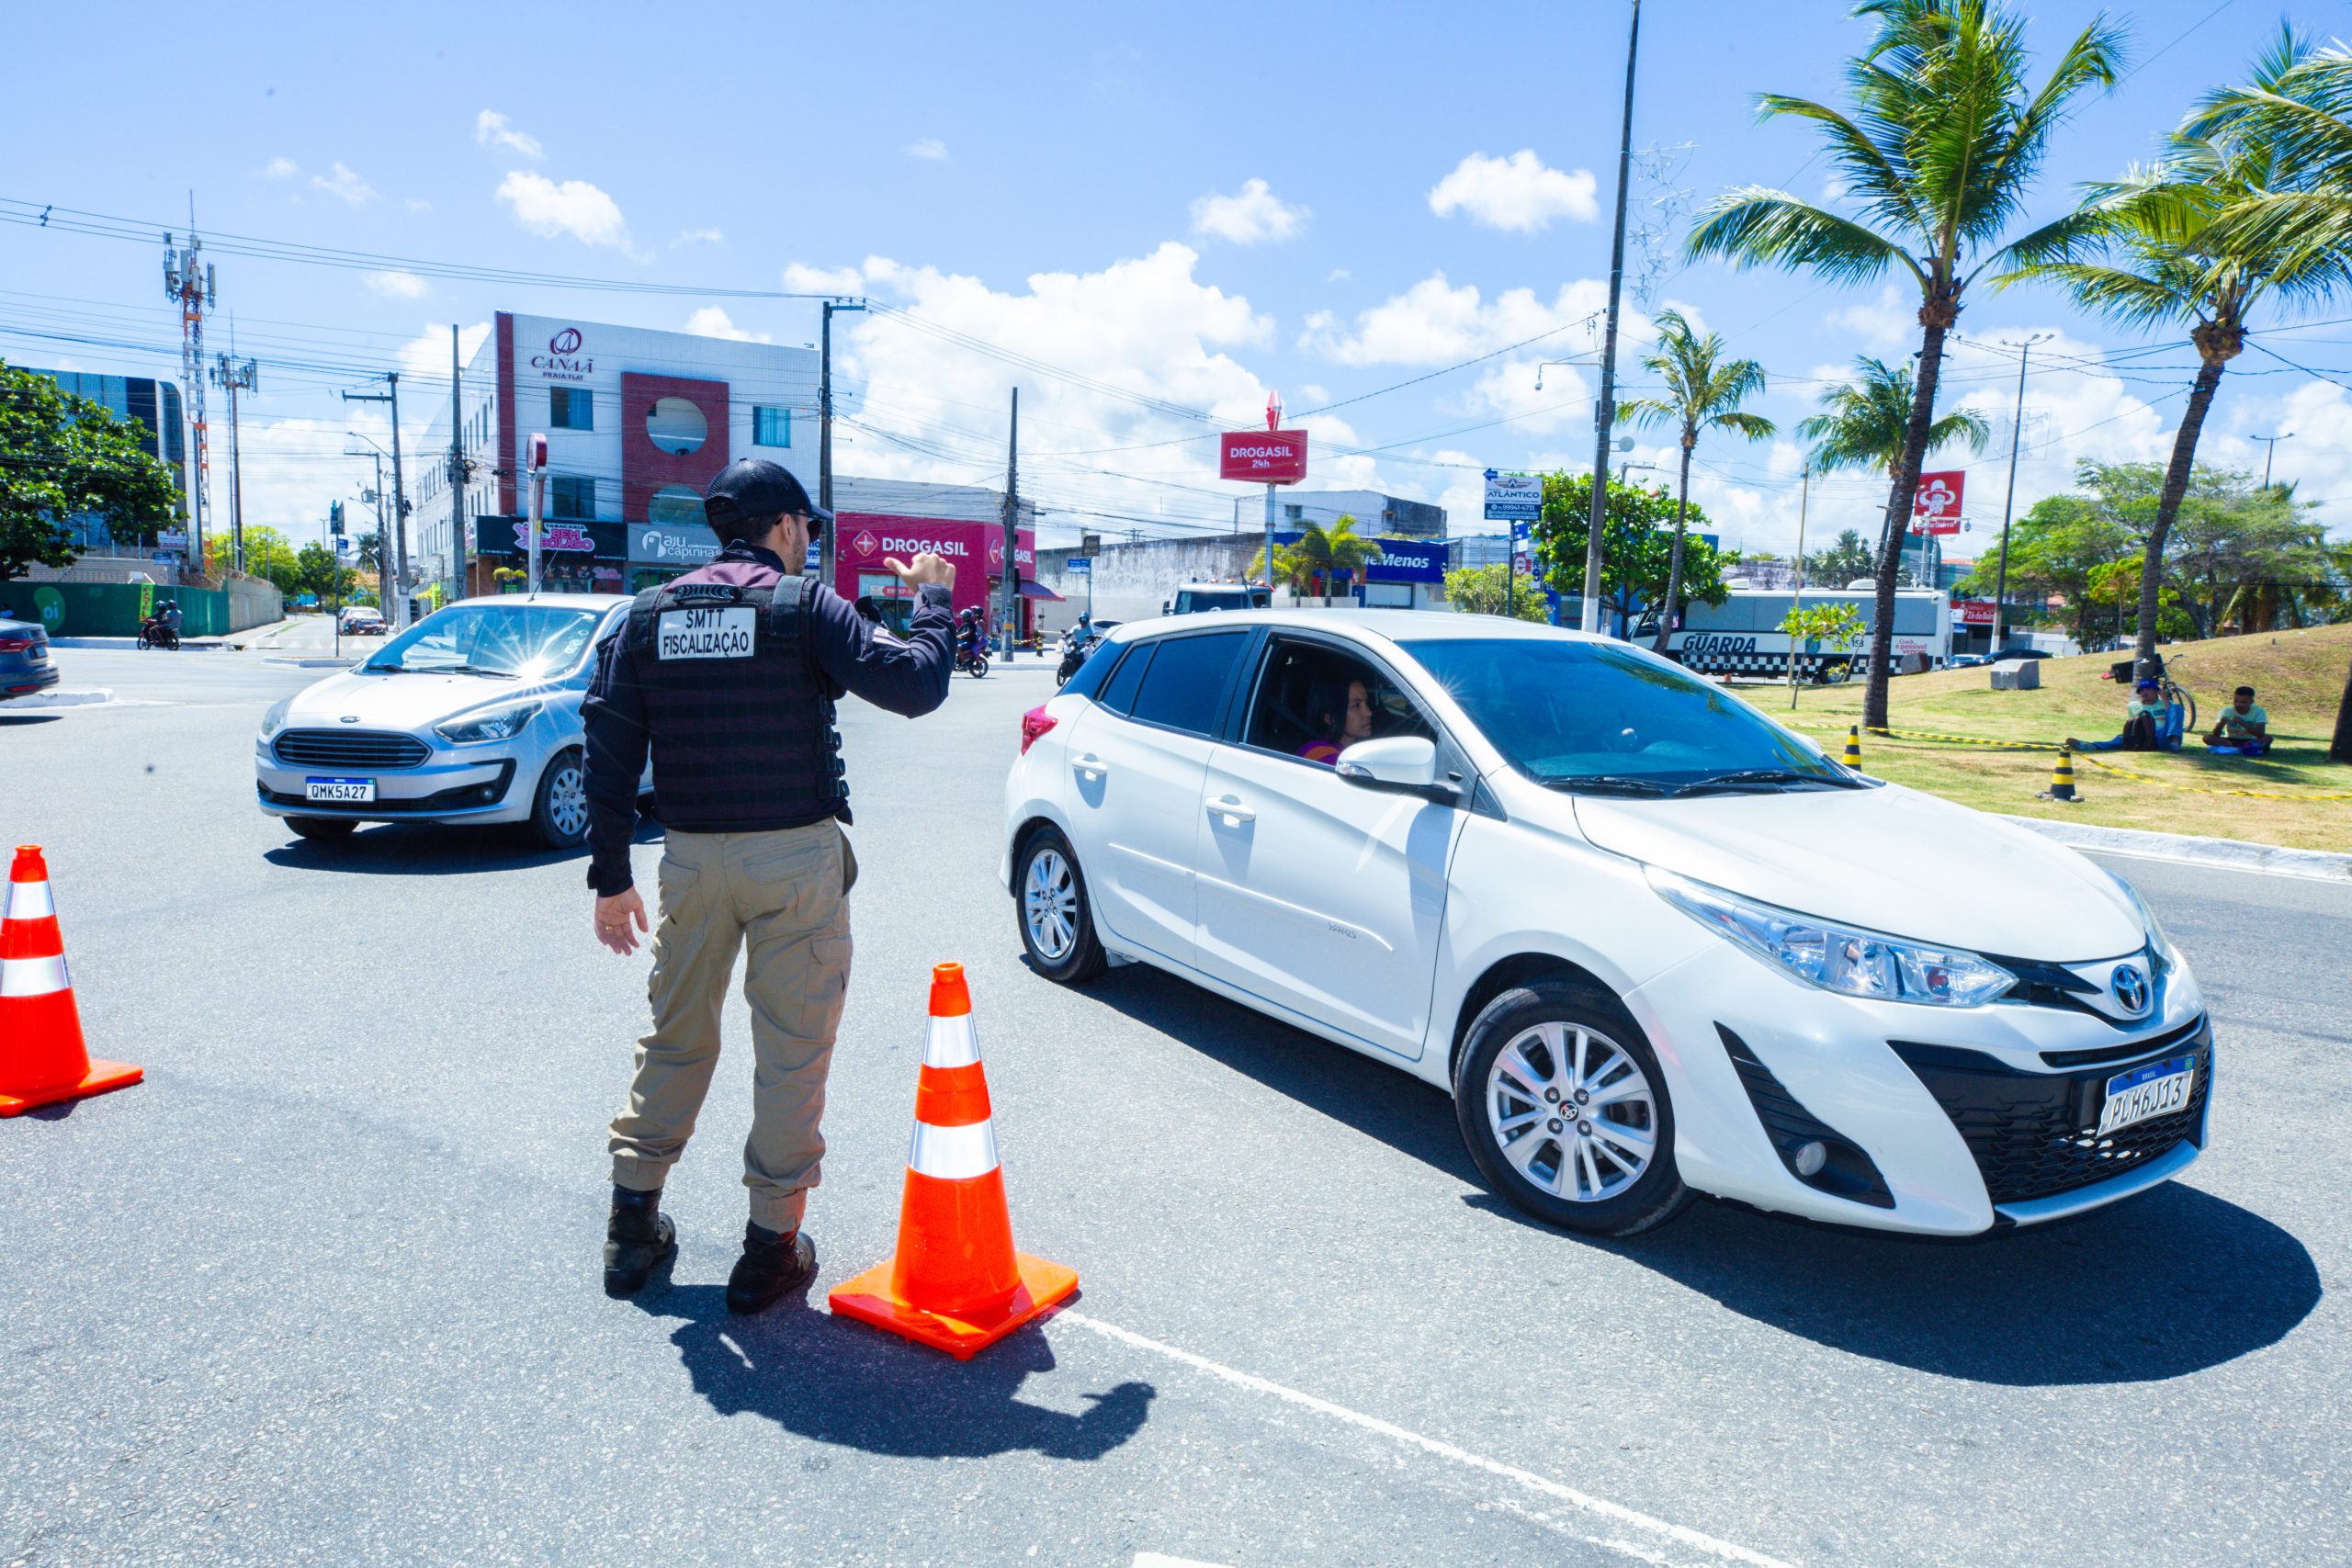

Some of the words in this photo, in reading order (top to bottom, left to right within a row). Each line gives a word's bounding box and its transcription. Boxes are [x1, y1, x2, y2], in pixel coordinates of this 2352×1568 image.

[531, 356, 594, 373] CANAÃ
[1230, 446, 1293, 457] DROGASIL
[1251, 459, 1270, 468] 24h
[1487, 490, 1540, 499] ATLÂNTICO
[551, 528, 581, 540] BEM
[540, 536, 593, 550] BOLADO
[882, 537, 969, 557] DROGASIL
[1001, 546, 1033, 563] DGASIL
[43, 601, 59, 620] oi
[686, 609, 725, 629] SMTT
[663, 625, 749, 658] FISCALIZAÇÃO
[1683, 635, 1757, 653] GUARDA
[311, 785, 367, 799] QMK5A27
